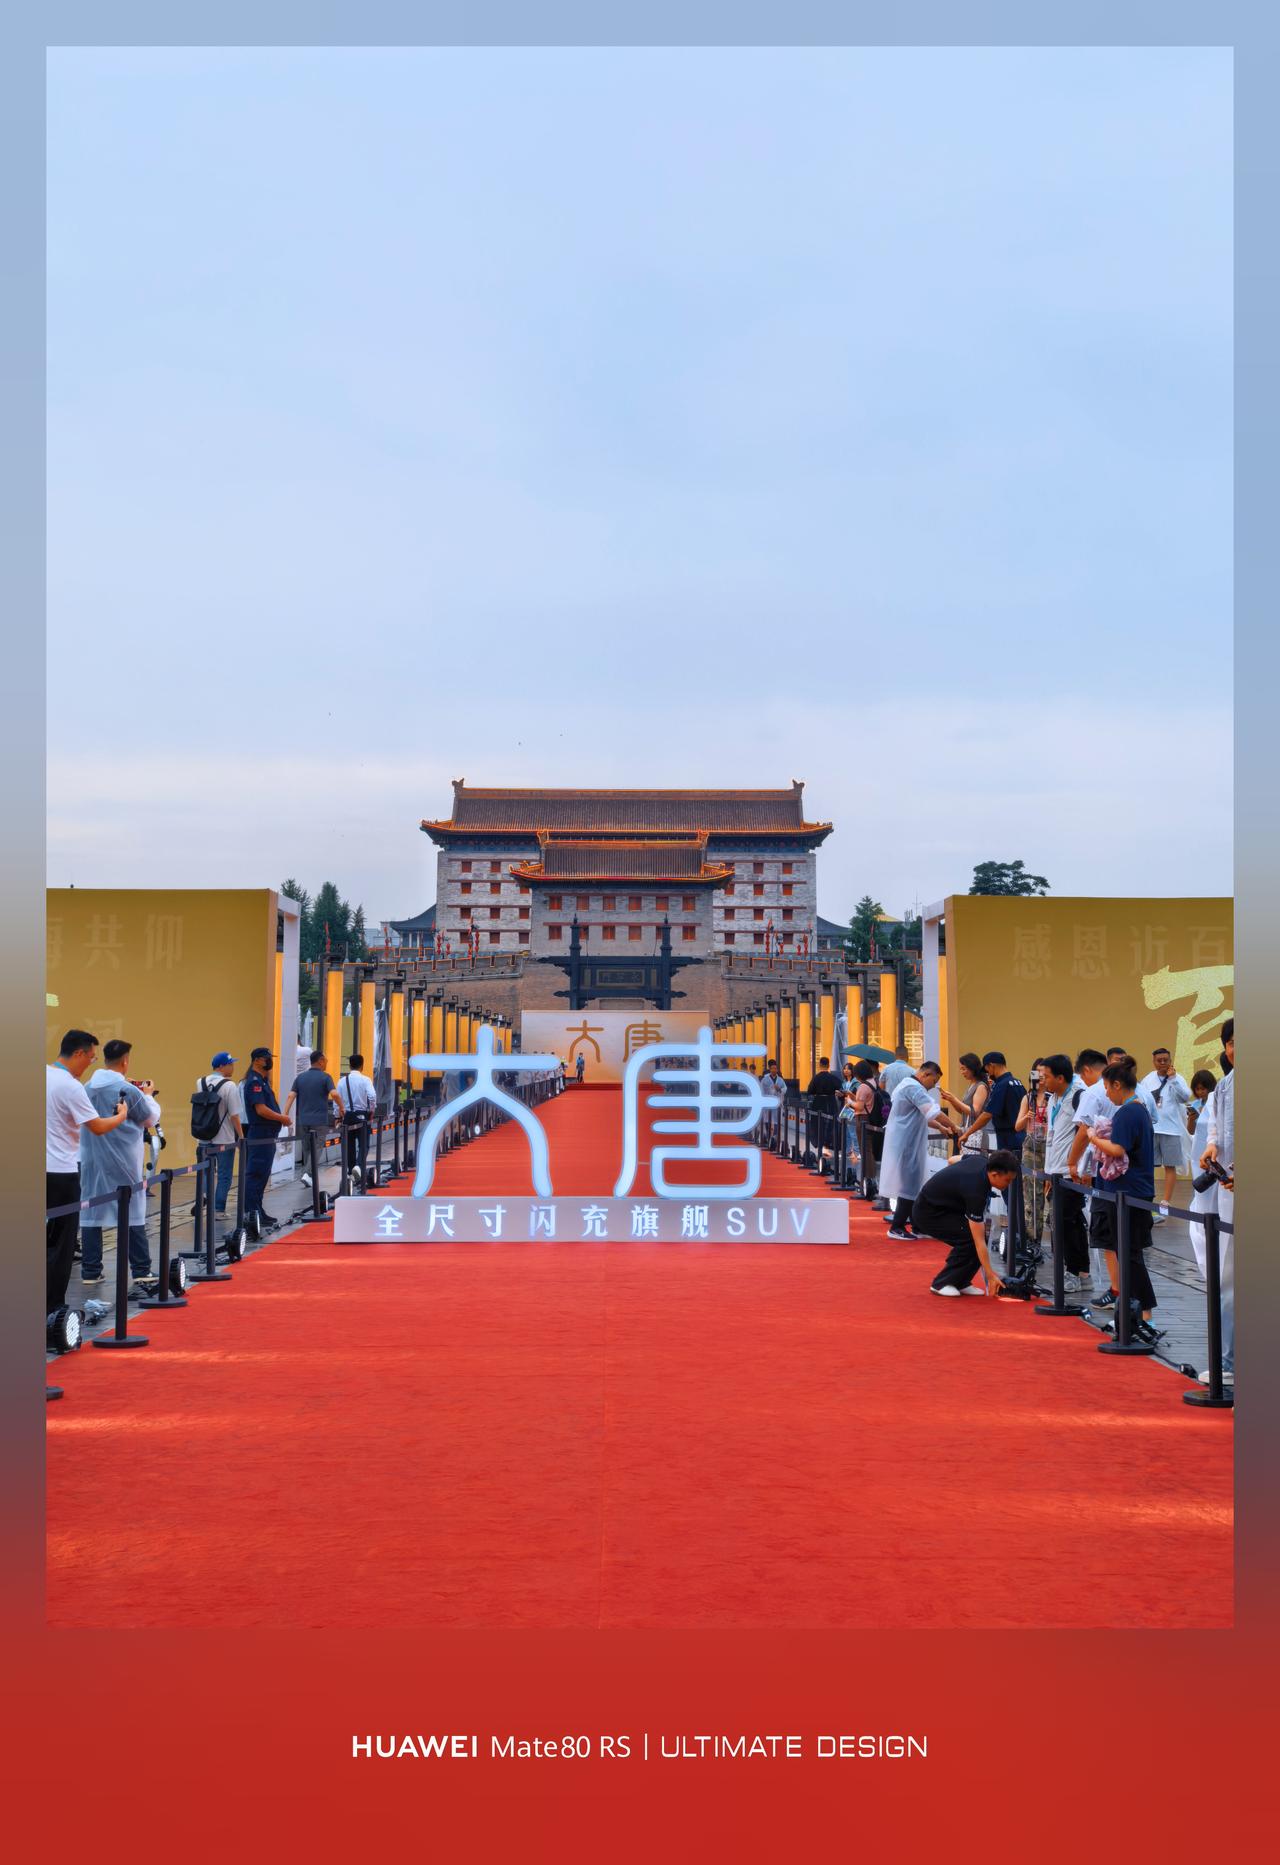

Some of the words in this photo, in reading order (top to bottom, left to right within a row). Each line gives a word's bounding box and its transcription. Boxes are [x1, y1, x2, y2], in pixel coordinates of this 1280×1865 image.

[409, 1024, 780, 1199] 大唐
[374, 1204, 811, 1238] 全尺寸闪充旗舰SUV
